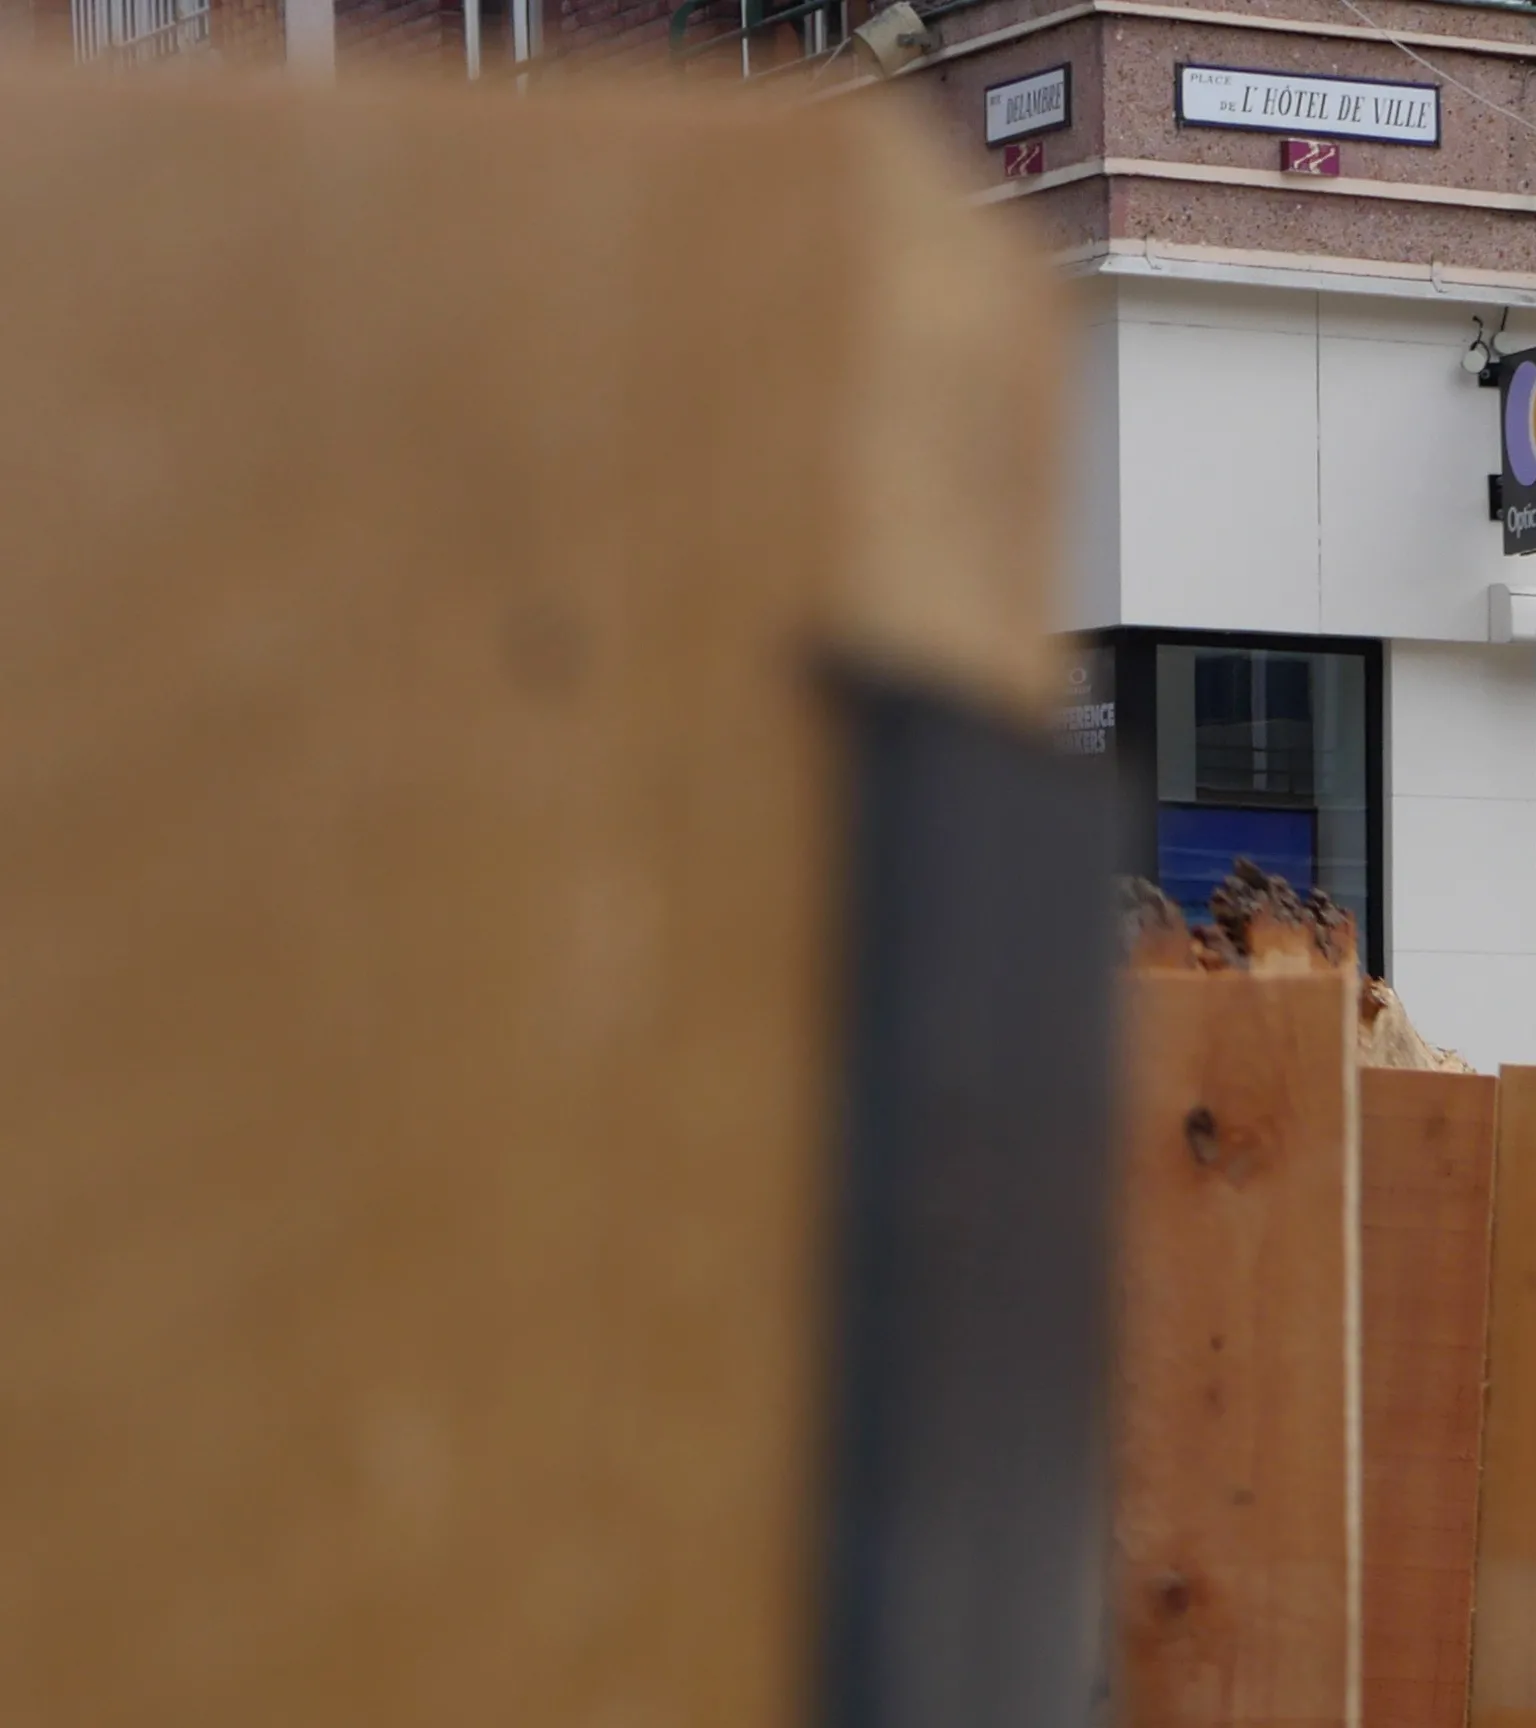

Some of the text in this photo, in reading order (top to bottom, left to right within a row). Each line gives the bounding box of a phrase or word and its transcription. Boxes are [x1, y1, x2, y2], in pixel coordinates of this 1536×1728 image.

[1190, 73, 1232, 86] PLACE
[1220, 101, 1236, 111] DE
[1336, 94, 1365, 123] DE
[1374, 97, 1432, 129] VILLE
